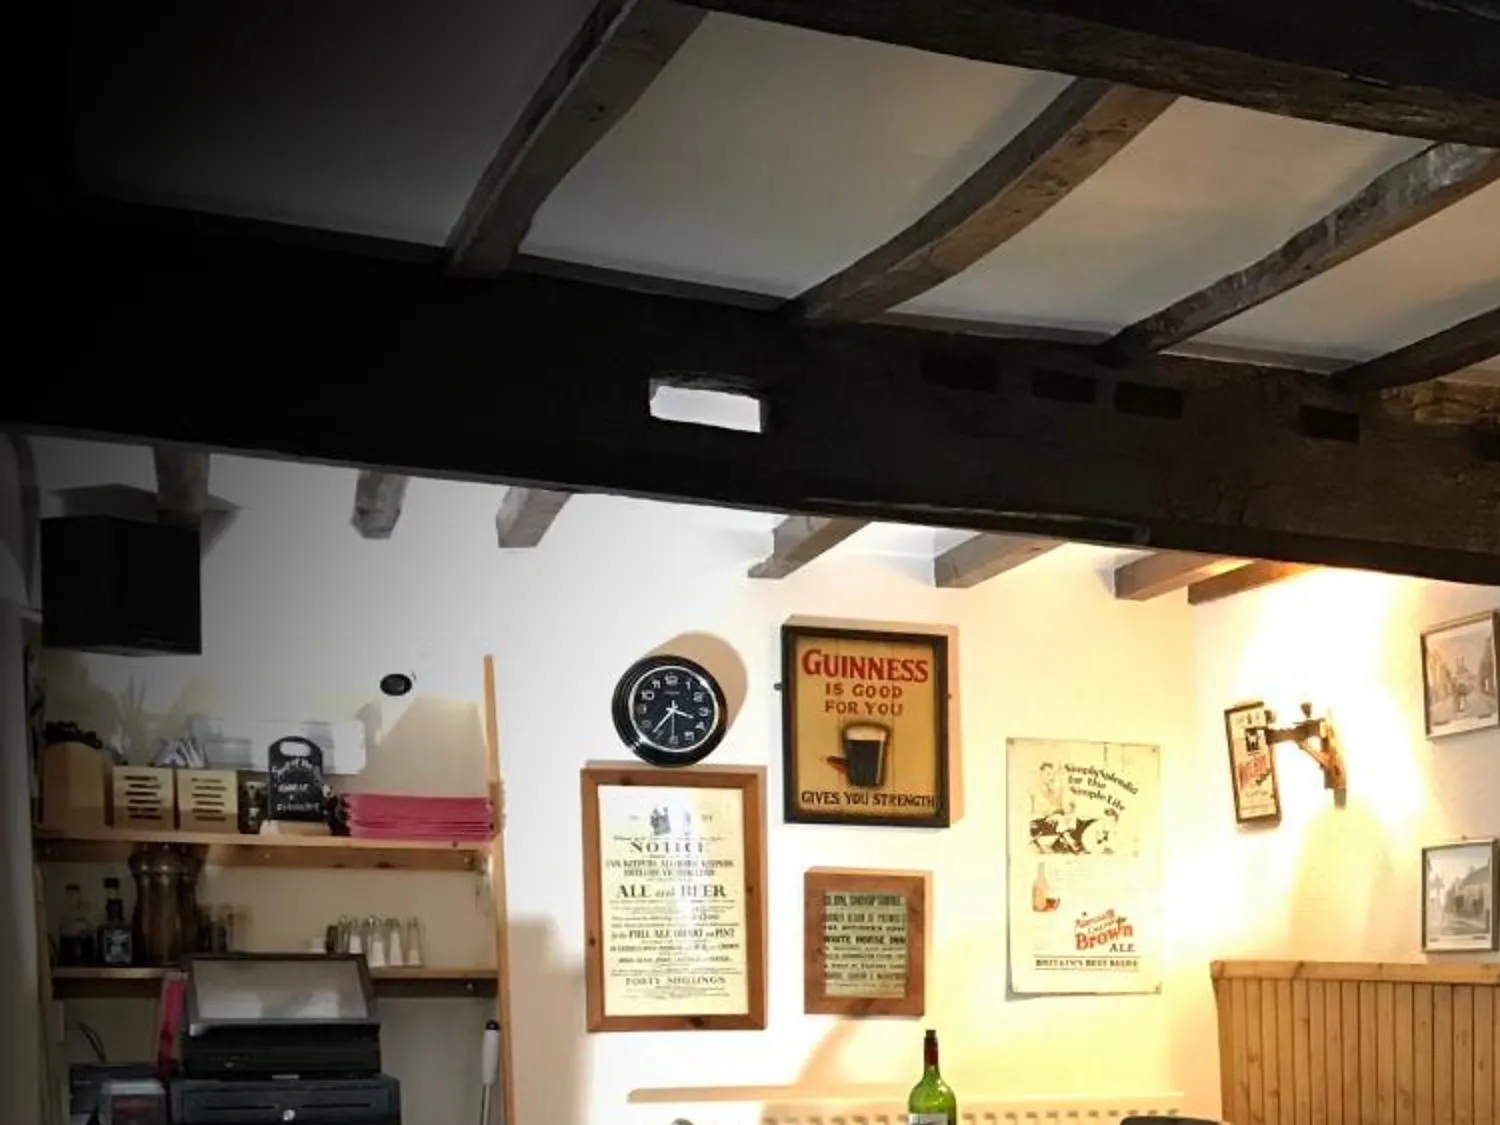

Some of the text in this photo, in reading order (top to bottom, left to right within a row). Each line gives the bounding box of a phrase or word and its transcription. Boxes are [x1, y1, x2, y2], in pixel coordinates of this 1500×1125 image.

[801, 648, 929, 683] GUINNESS
[651, 679, 661, 689] 11
[825, 682, 904, 699] IS GOOD
[641, 690, 655, 701] 10
[698, 707, 709, 717] 3
[824, 699, 904, 715] FOR YOU
[695, 721, 706, 732] 4
[1087, 777, 1106, 789] the
[801, 790, 936, 808] GIVES YOU STRENGTH
[616, 883, 652, 898] ALE
[681, 883, 728, 898] BEER
[1075, 924, 1134, 950] Brown
[1109, 943, 1136, 953] ALE
